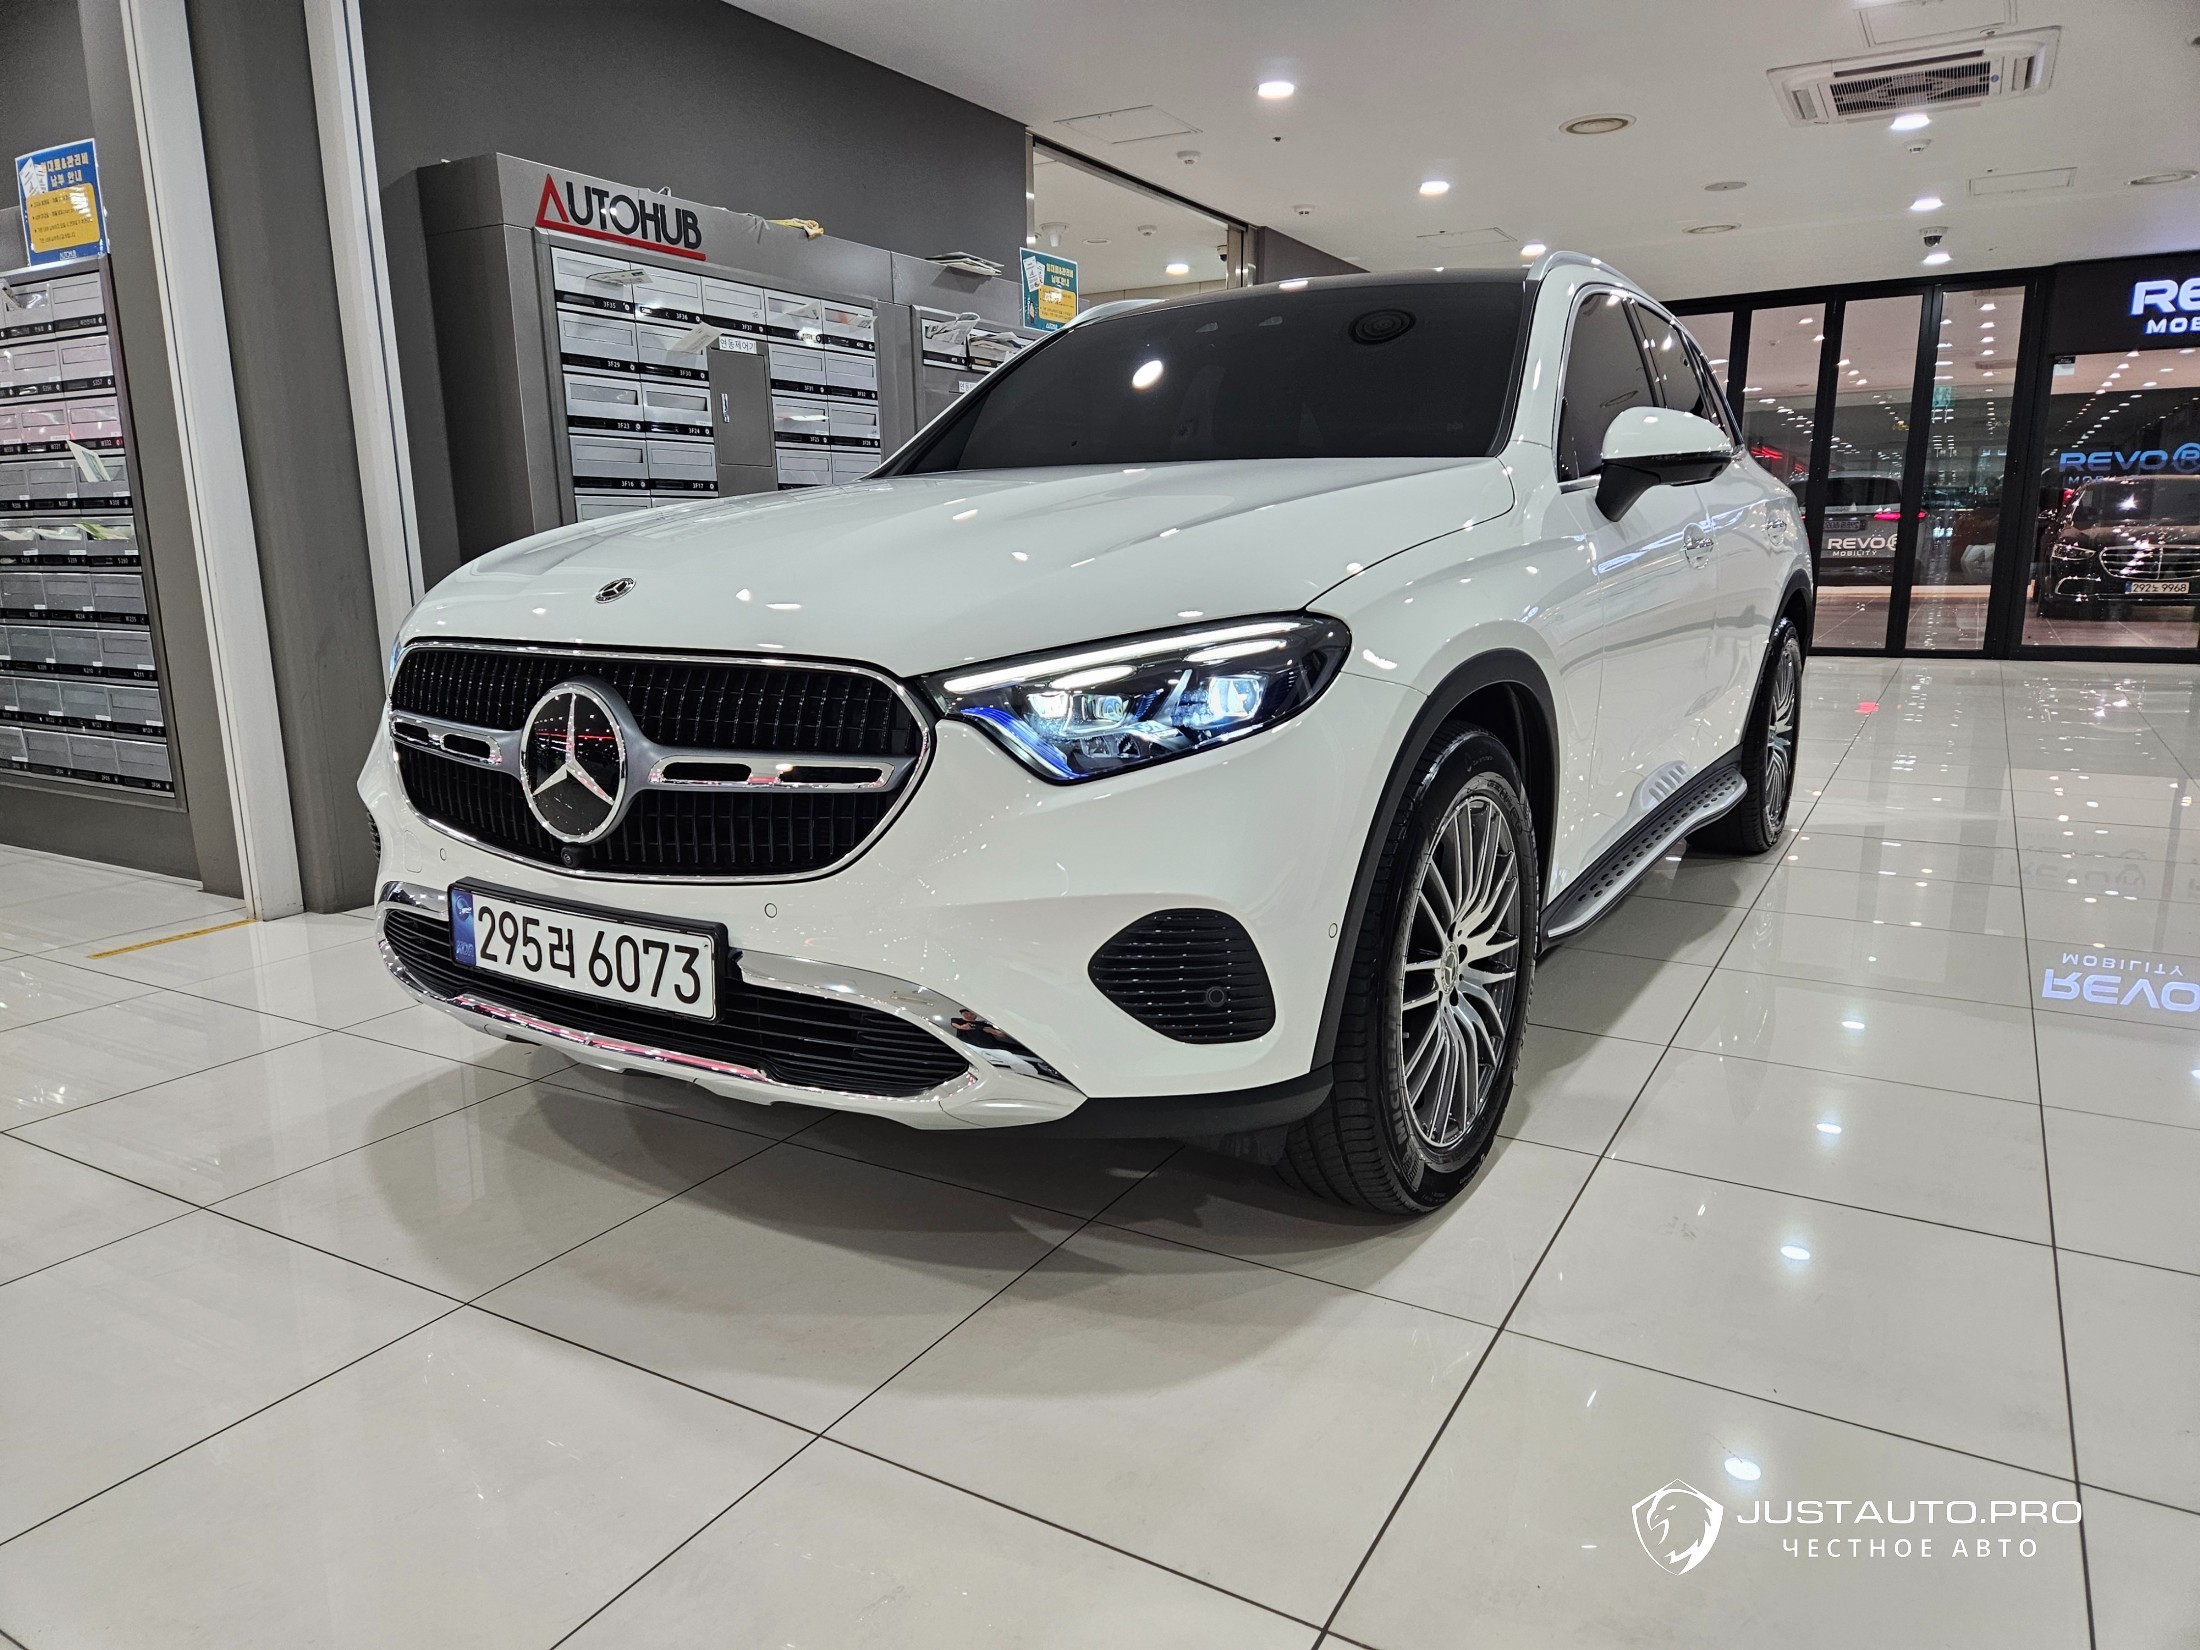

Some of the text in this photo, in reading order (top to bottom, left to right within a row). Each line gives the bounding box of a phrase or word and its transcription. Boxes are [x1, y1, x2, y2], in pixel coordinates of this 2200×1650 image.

[535, 173, 703, 250] AUTOHUB
[603, 300, 616, 309] 3F35
[676, 312, 688, 321] 3F36
[720, 339, 757, 352] 연동제어기
[607, 360, 620, 368] 3F29
[679, 369, 692, 377] 3F30
[617, 422, 630, 430] 3F23
[2059, 450, 2169, 473] REVO
[1827, 538, 1886, 549] REVO
[2162, 583, 2187, 592] 9968
[478, 905, 701, 1005] 295러 6073
